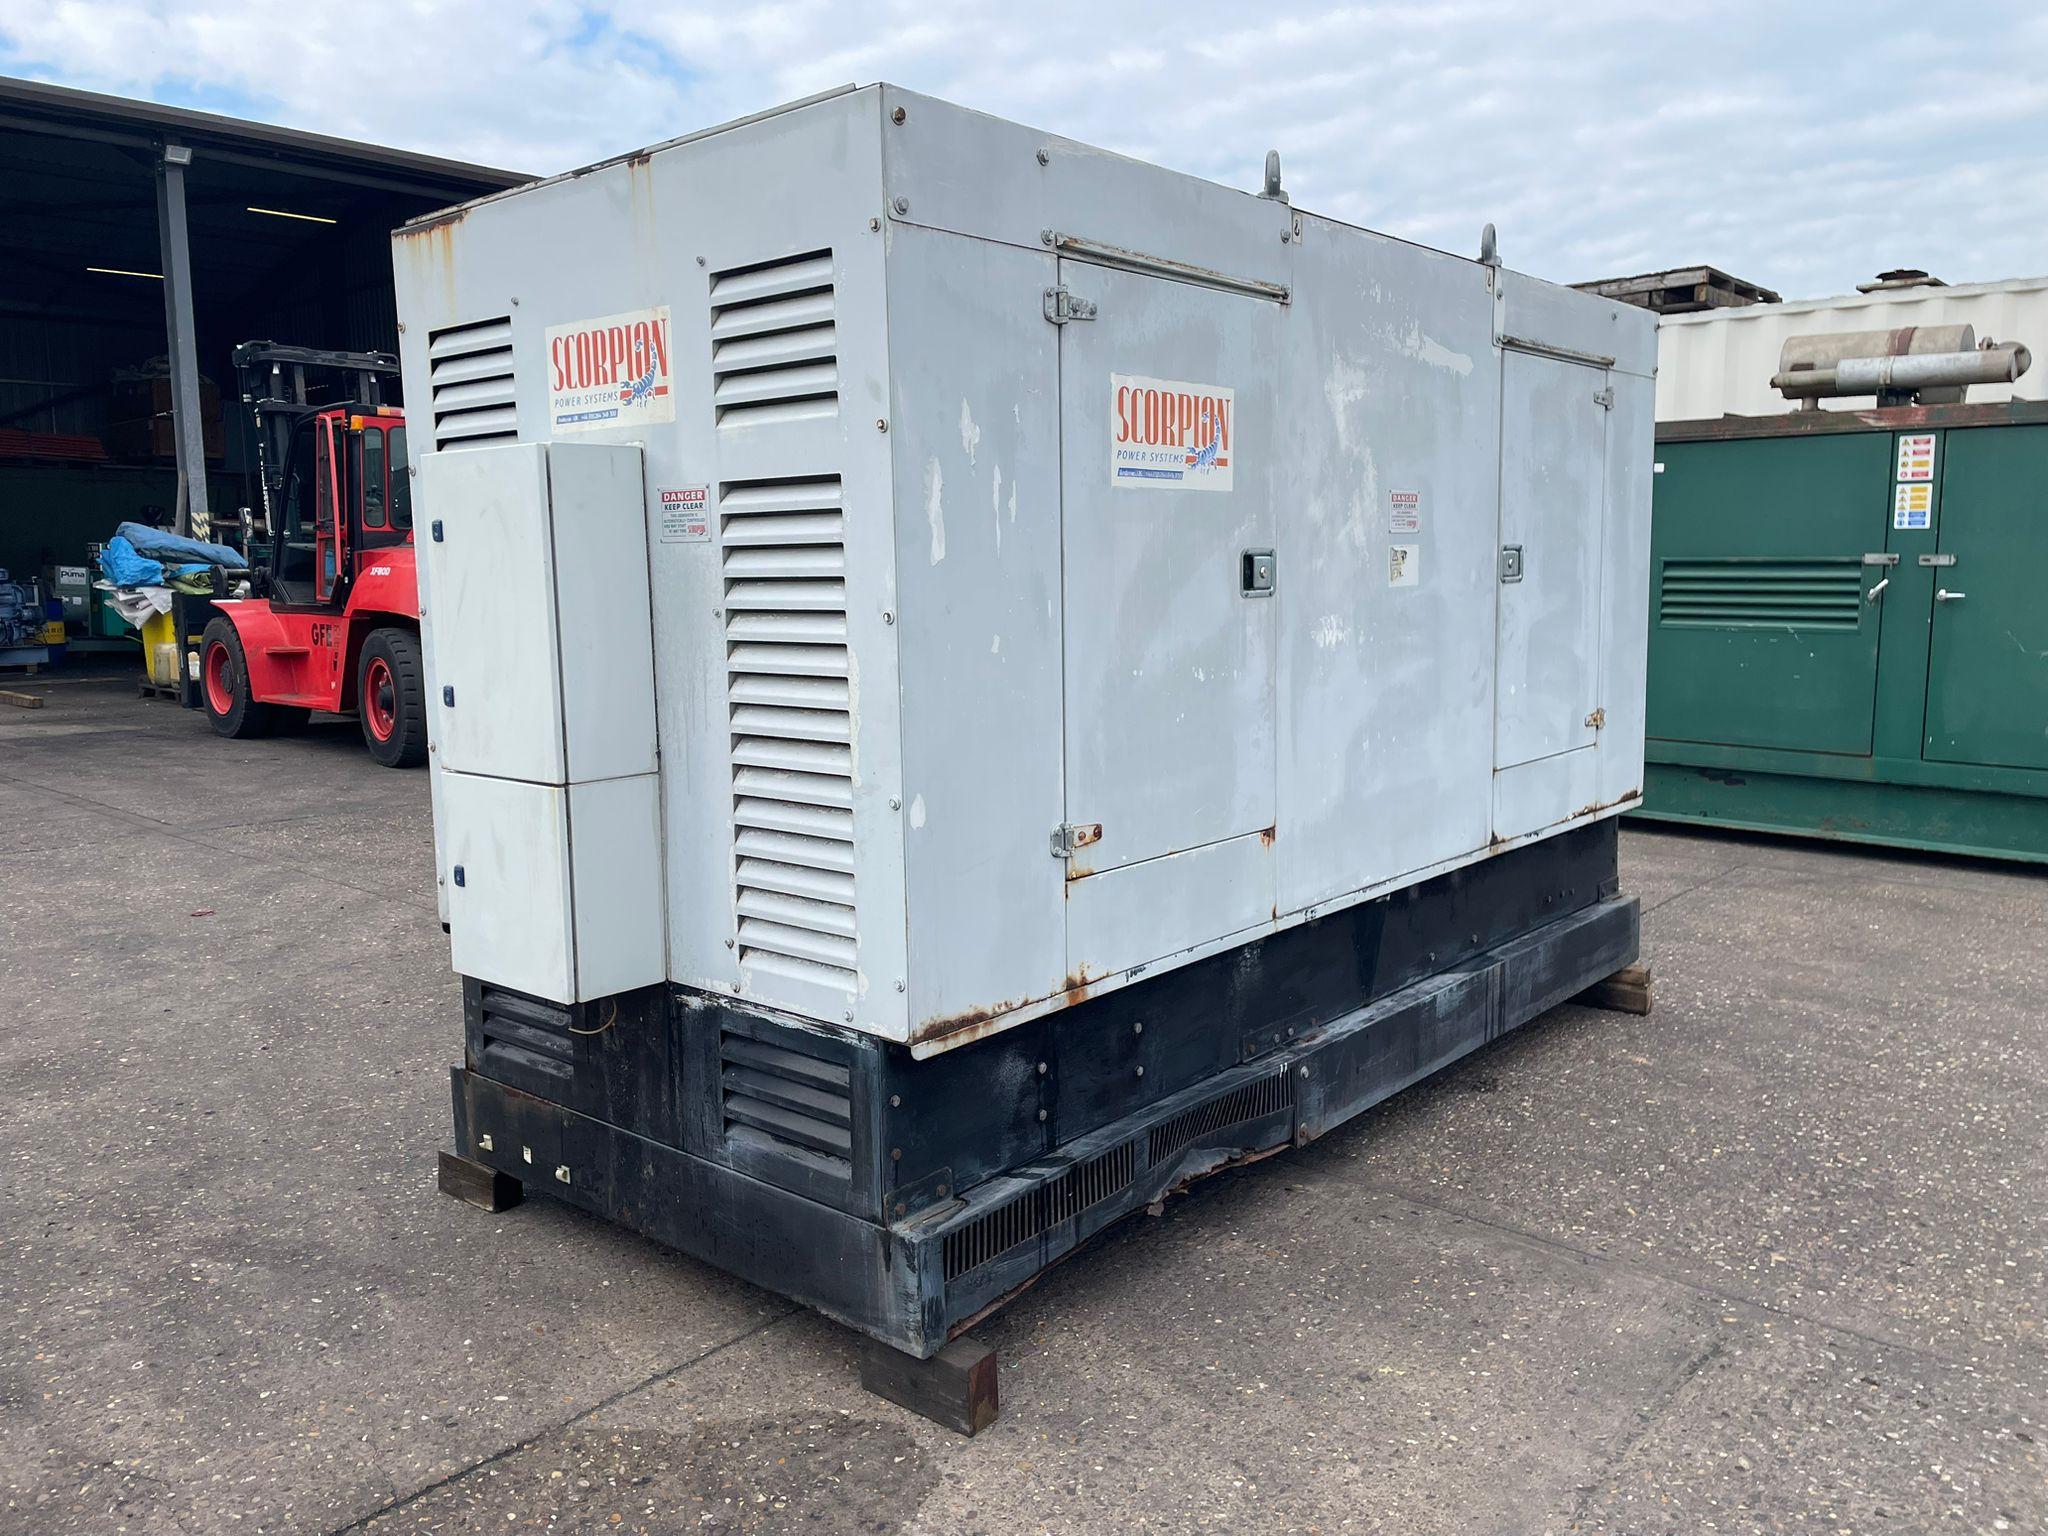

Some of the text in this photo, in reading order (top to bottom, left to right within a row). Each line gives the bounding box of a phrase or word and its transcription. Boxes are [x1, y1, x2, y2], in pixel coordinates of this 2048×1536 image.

[552, 318, 668, 392] SCORPION
[554, 391, 618, 408] POWER SYSTEMS
[1116, 385, 1231, 451] SCORPION
[1116, 450, 1184, 464] POWER SYSTEMS
[664, 492, 703, 502] DANGER
[1393, 494, 1416, 502] DANGER
